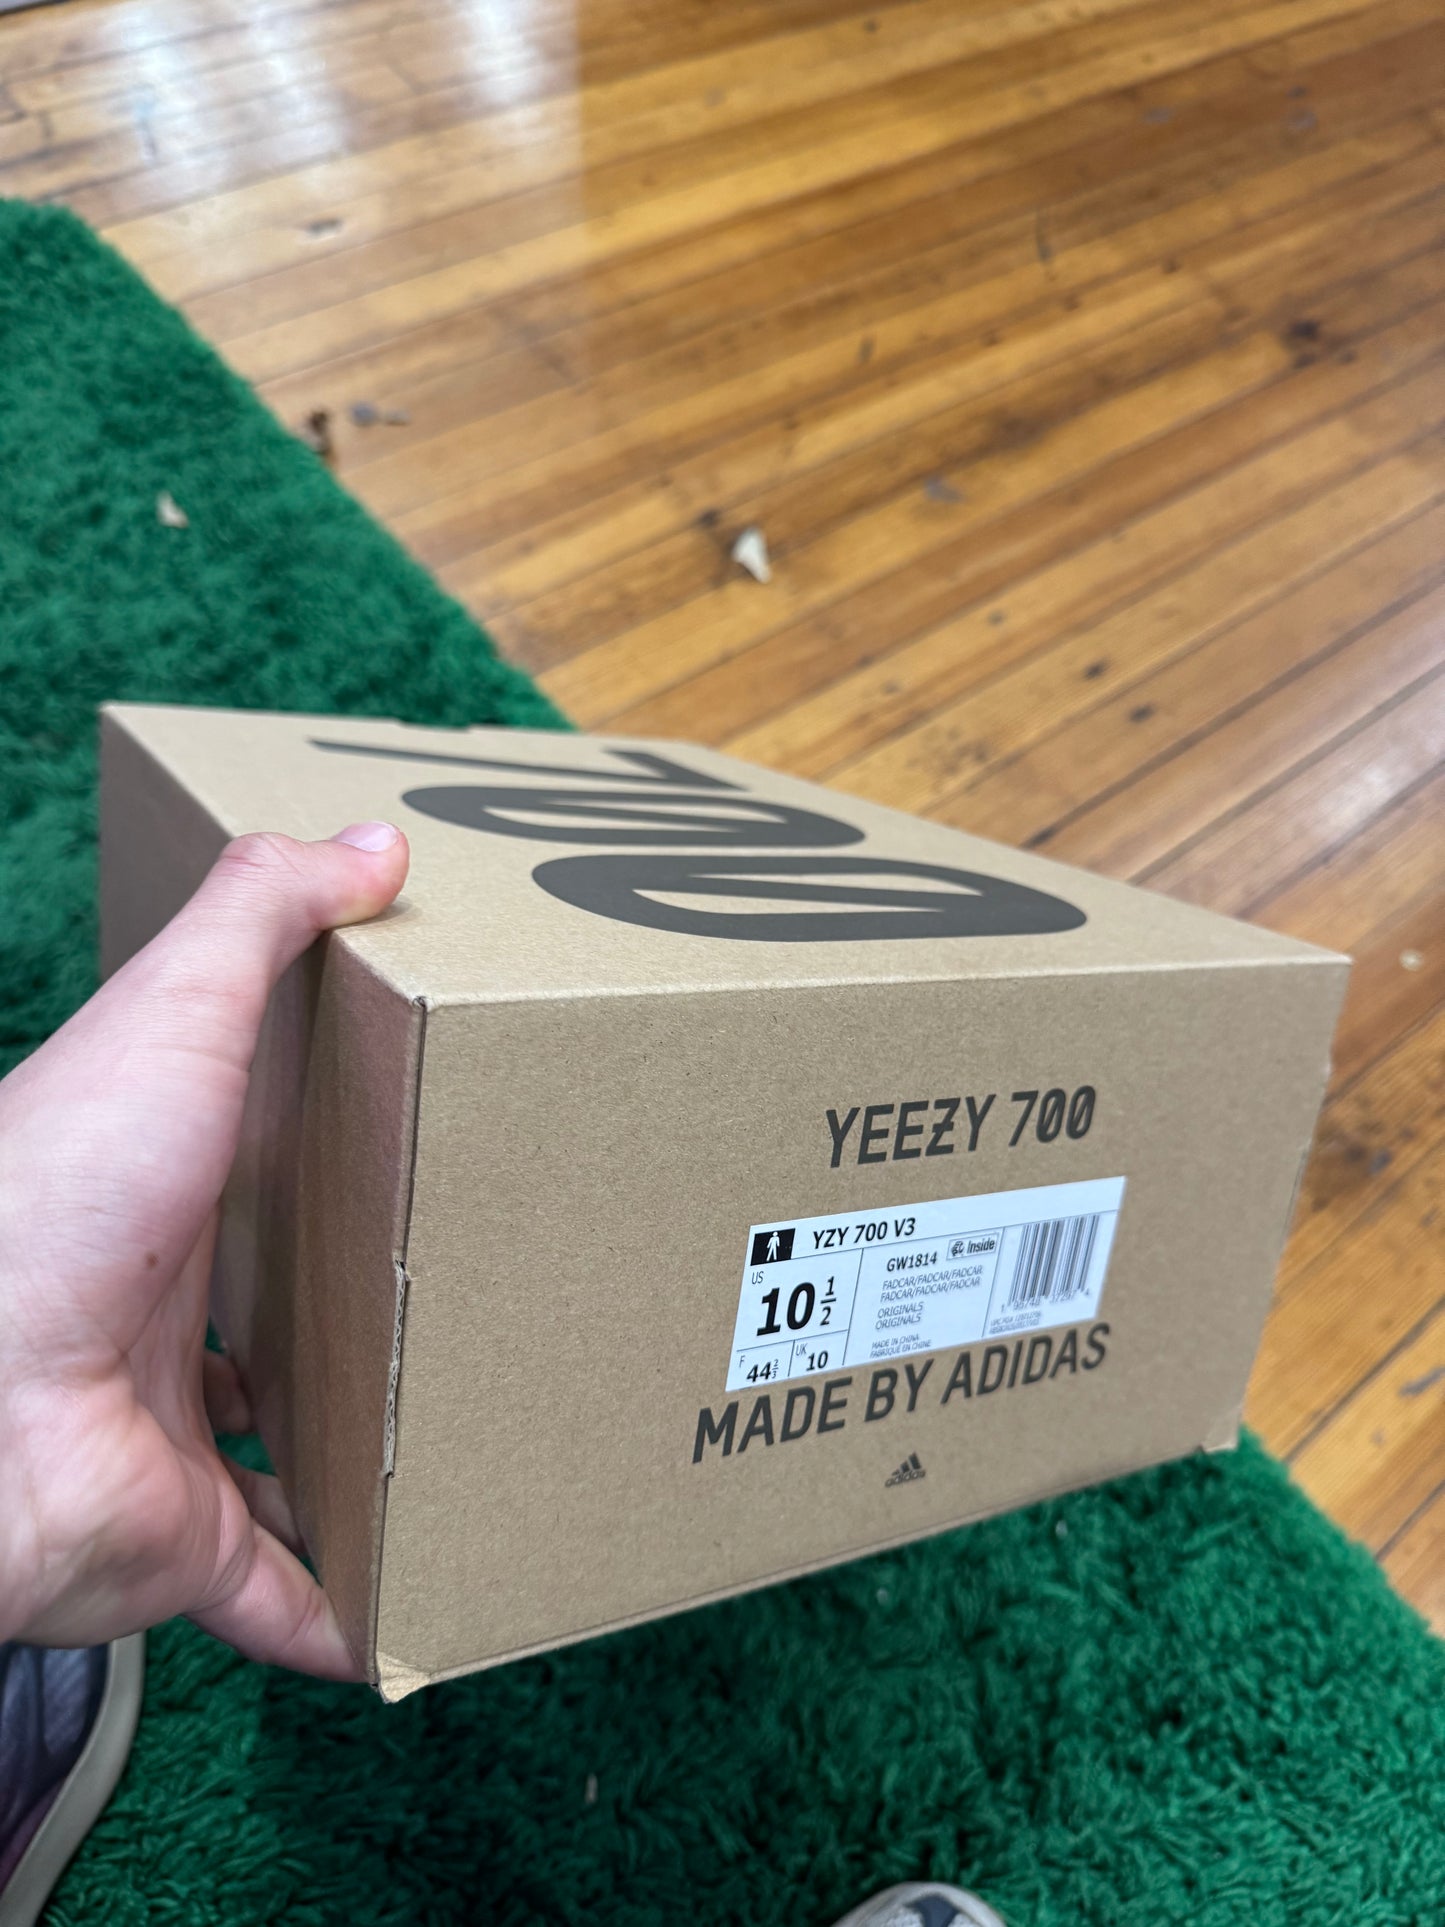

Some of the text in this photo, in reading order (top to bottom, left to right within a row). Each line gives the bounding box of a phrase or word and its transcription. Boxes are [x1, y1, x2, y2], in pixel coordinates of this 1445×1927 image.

[826, 1085, 1096, 1168] YEEZY 700
[813, 1217, 916, 1250] YZY 700 V3
[967, 1237, 995, 1255] Inside
[887, 1251, 938, 1273] GW1814
[751, 1271, 764, 1285] US
[883, 1265, 983, 1290] FADCAR/FADCAR/FADCAR
[880, 1277, 981, 1302] FADCAR/FADCAR/FADCAR
[756, 1282, 815, 1336] 10
[877, 1301, 924, 1319] ORIGINALS
[875, 1313, 922, 1331] ORIGINALS
[796, 1343, 808, 1356] UK
[872, 1338, 889, 1350] MADE
[891, 1336, 899, 1346] IN
[739, 1355, 745, 1368] F
[806, 1350, 829, 1371] 10
[746, 1361, 771, 1382] 44
[692, 1323, 1111, 1464] MADE BY ADIDAS
[885, 1469, 926, 1488] adidas
